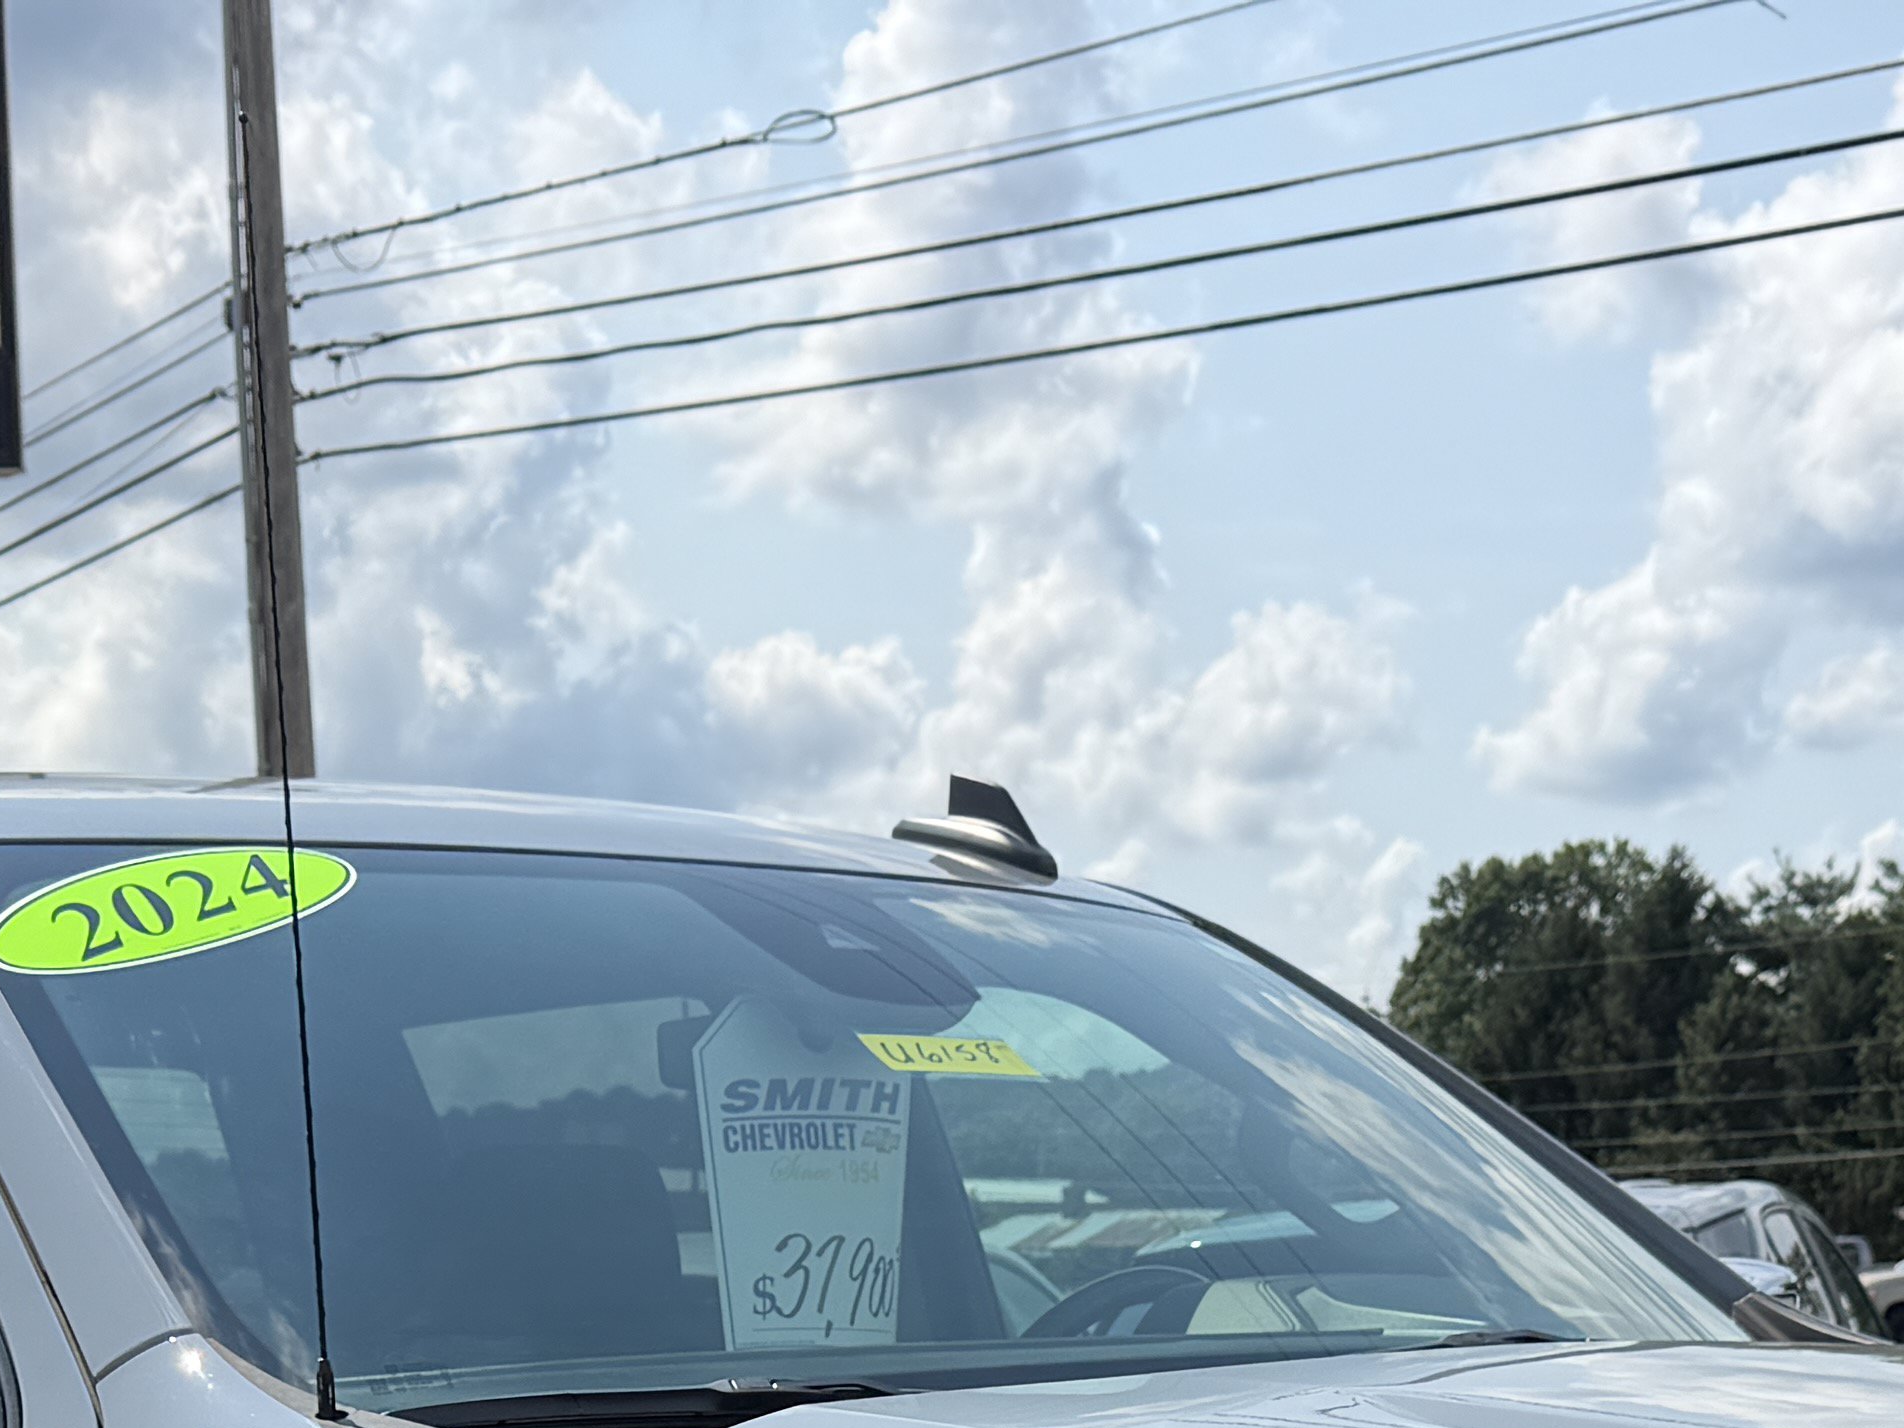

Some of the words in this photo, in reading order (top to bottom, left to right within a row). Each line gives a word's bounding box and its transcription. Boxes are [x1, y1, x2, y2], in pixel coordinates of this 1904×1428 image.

[51, 853, 291, 961] 2024
[720, 1078, 900, 1115] SMITH
[723, 1121, 857, 1154] CHEVROLET
